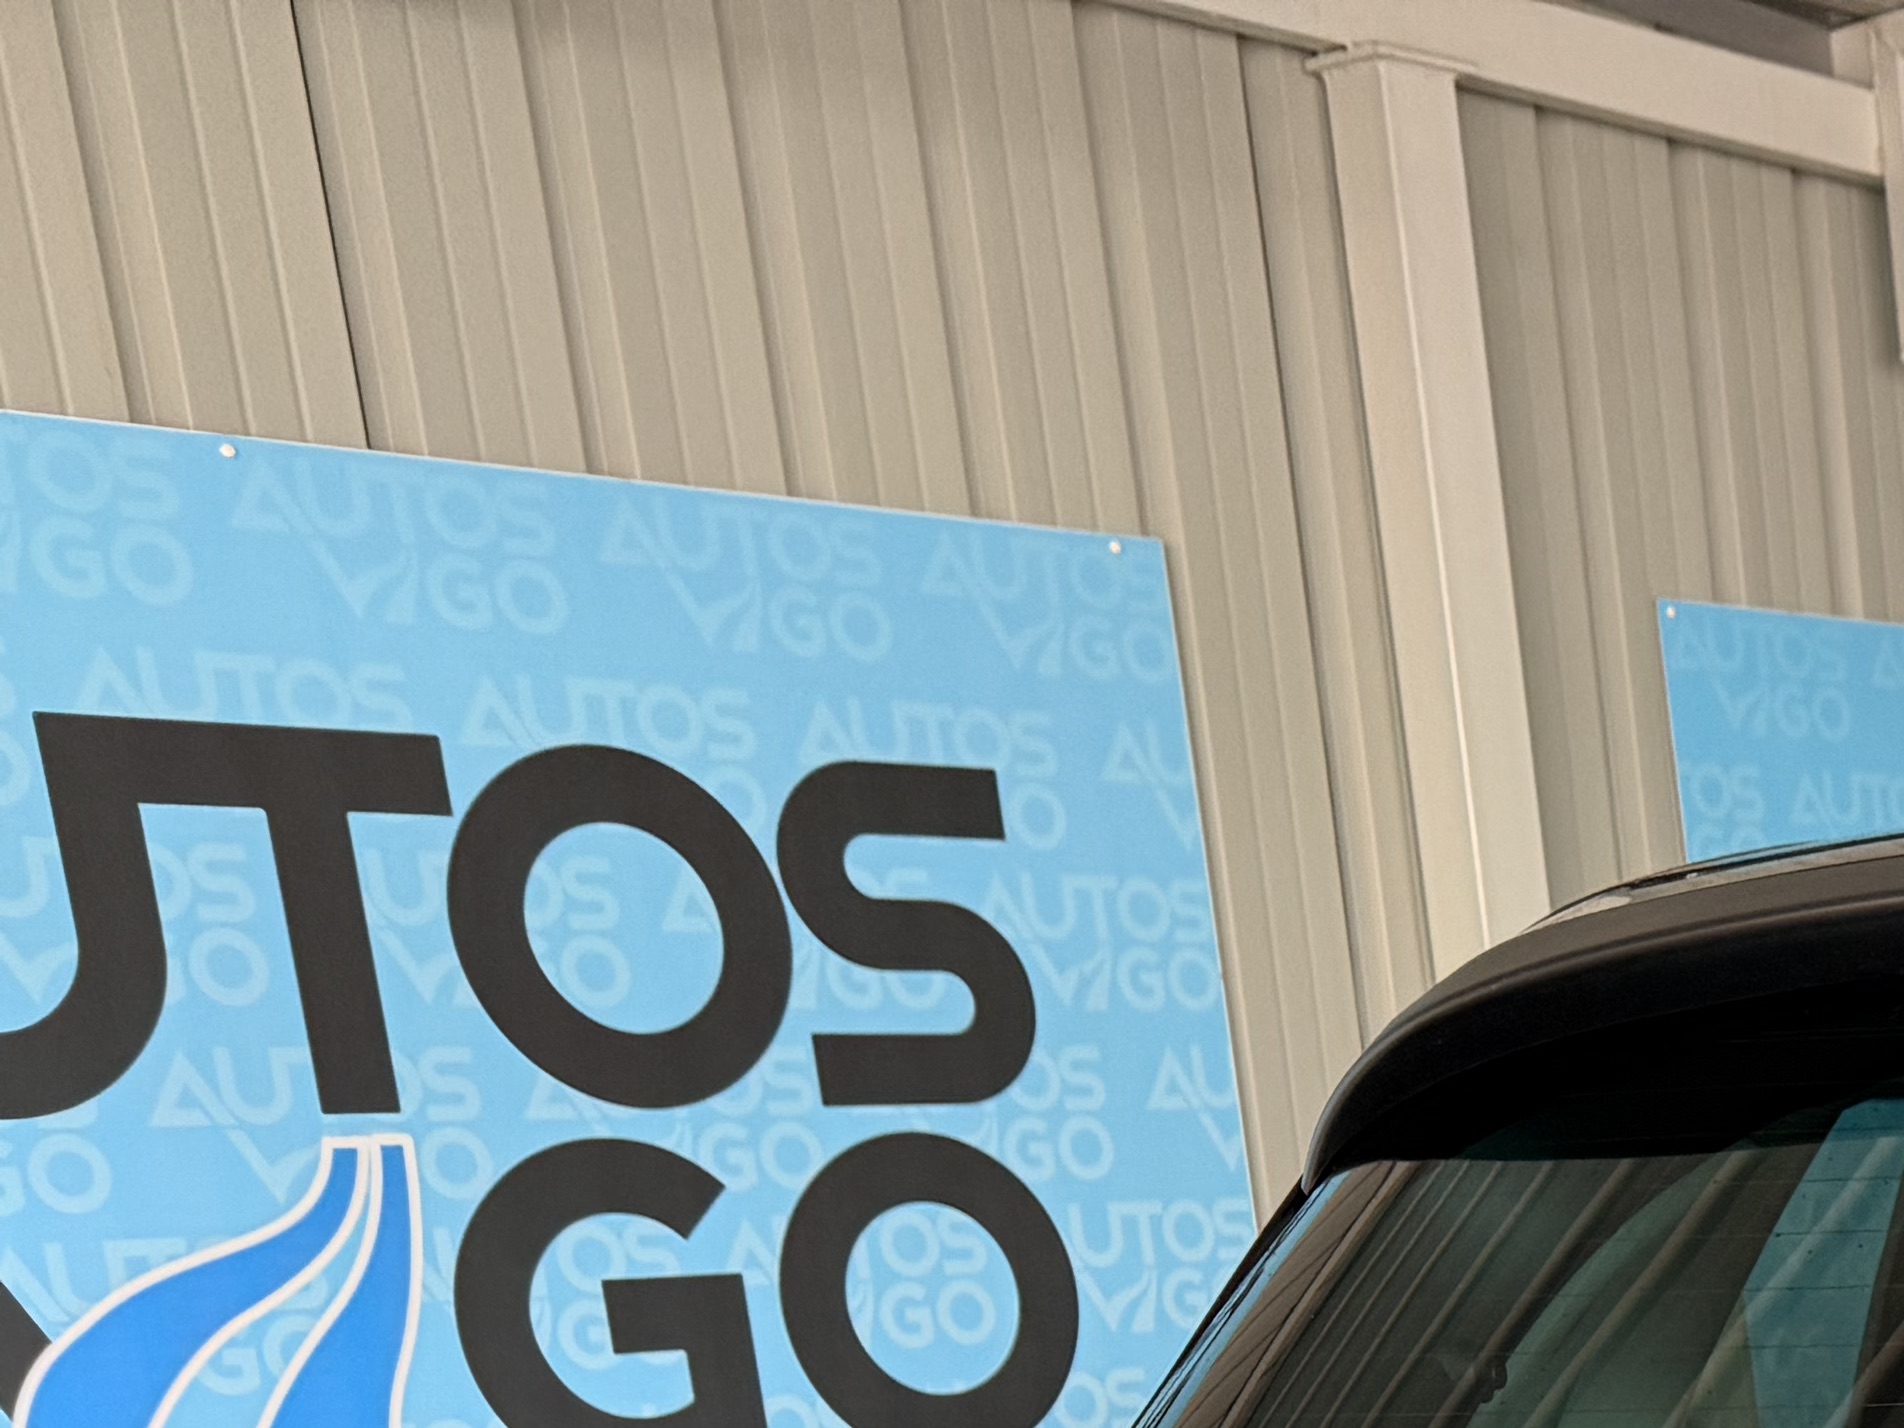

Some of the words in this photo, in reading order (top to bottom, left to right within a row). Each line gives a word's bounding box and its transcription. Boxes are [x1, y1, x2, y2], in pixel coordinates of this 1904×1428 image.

[230, 454, 557, 557] AUTOS
[600, 493, 882, 588] AUTOS
[304, 535, 569, 636] VIGO
[665, 566, 894, 663] VIGO
[459, 672, 757, 760] AUTOS
